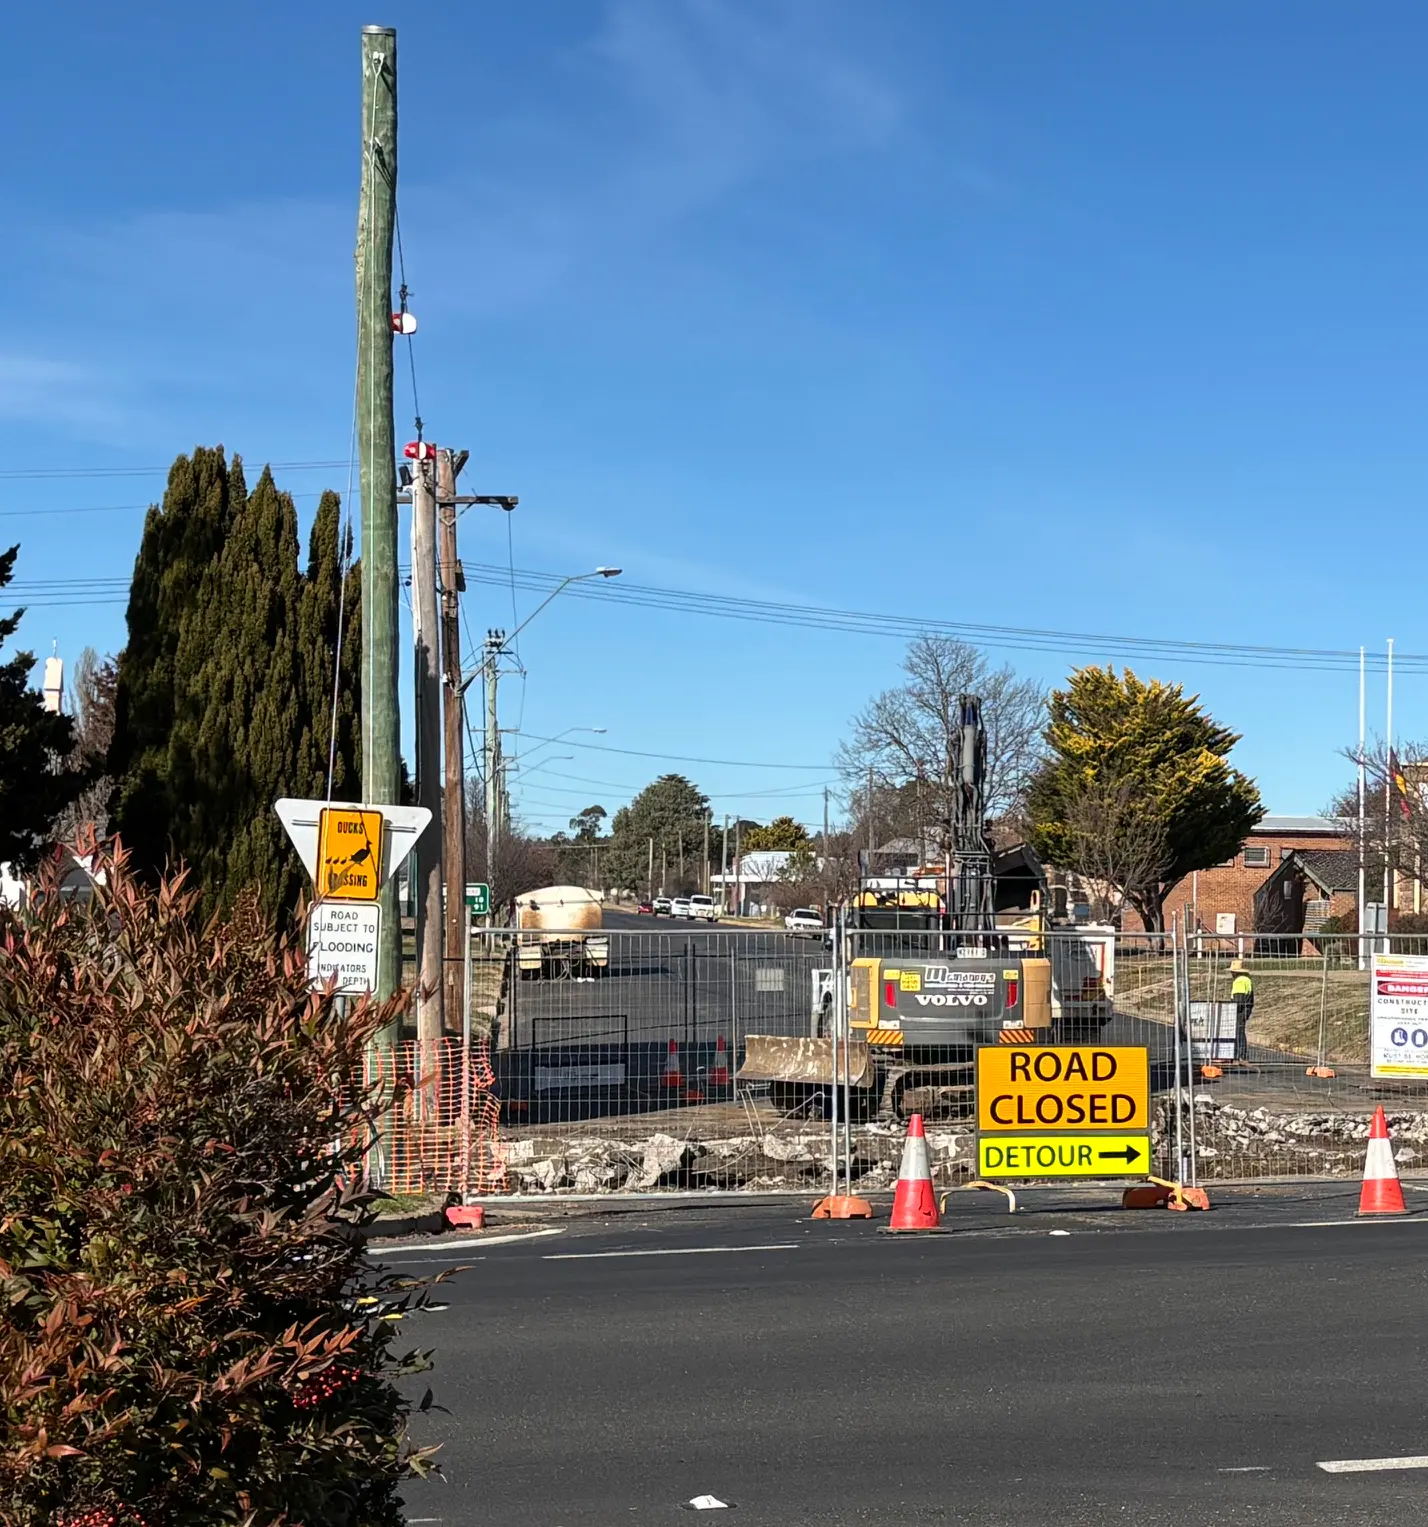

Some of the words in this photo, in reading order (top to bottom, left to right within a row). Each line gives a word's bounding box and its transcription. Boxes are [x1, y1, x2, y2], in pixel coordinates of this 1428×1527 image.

[337, 821, 363, 835] DUCKS
[330, 911, 359, 920] ROAD
[313, 922, 359, 932] SUBJECT
[363, 924, 375, 933] TO
[914, 994, 988, 1006] VOLVO
[1010, 1051, 1118, 1082] ROAD
[989, 1094, 1136, 1125] CLOSED
[985, 1145, 1093, 1168] DETOUR
